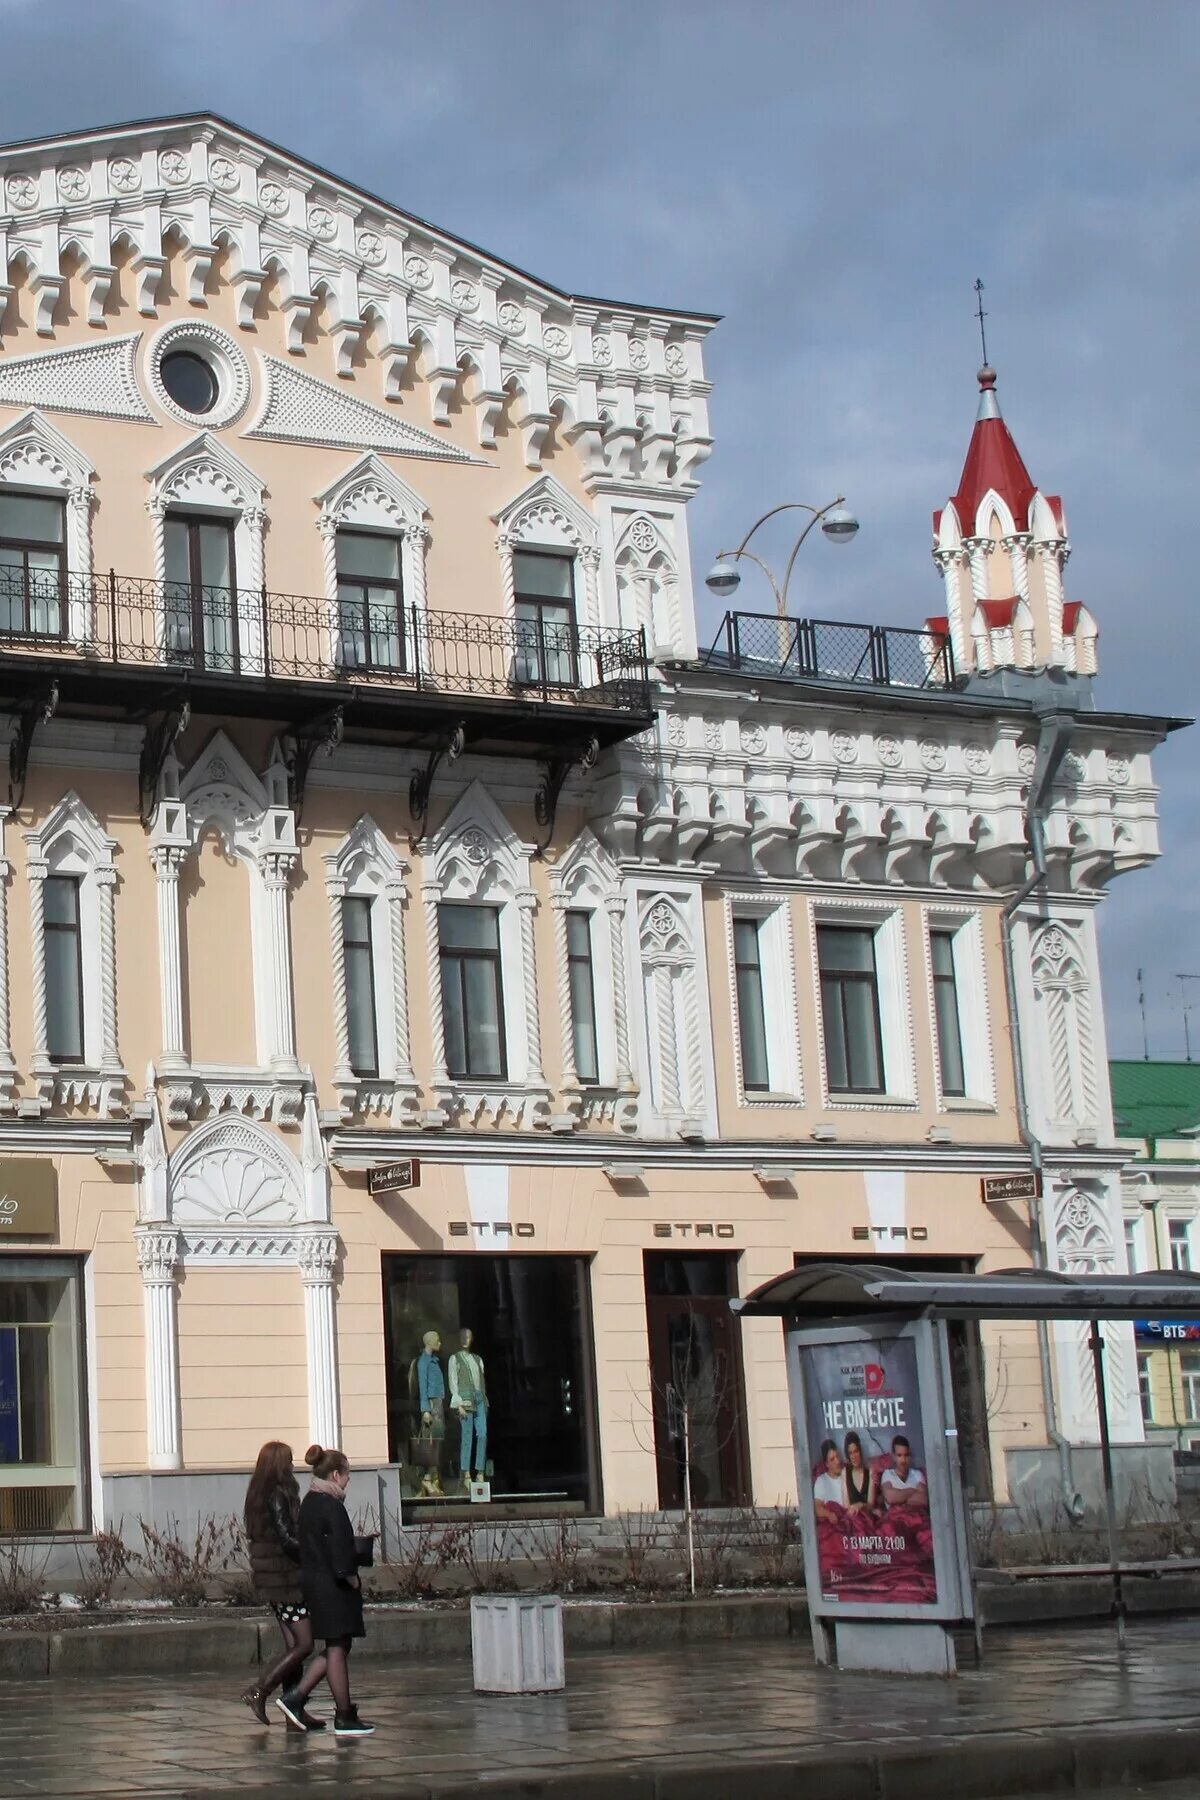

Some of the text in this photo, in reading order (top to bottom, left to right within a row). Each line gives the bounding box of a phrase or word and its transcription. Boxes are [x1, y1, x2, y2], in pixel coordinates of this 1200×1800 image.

[448, 1222, 535, 1237] ETRO
[653, 1224, 734, 1238] ETRO
[852, 1226, 928, 1240] ETRO
[823, 1397, 906, 1429] НЕ ВМЕСТЕ
[858, 1536, 883, 1550] МАРТА
